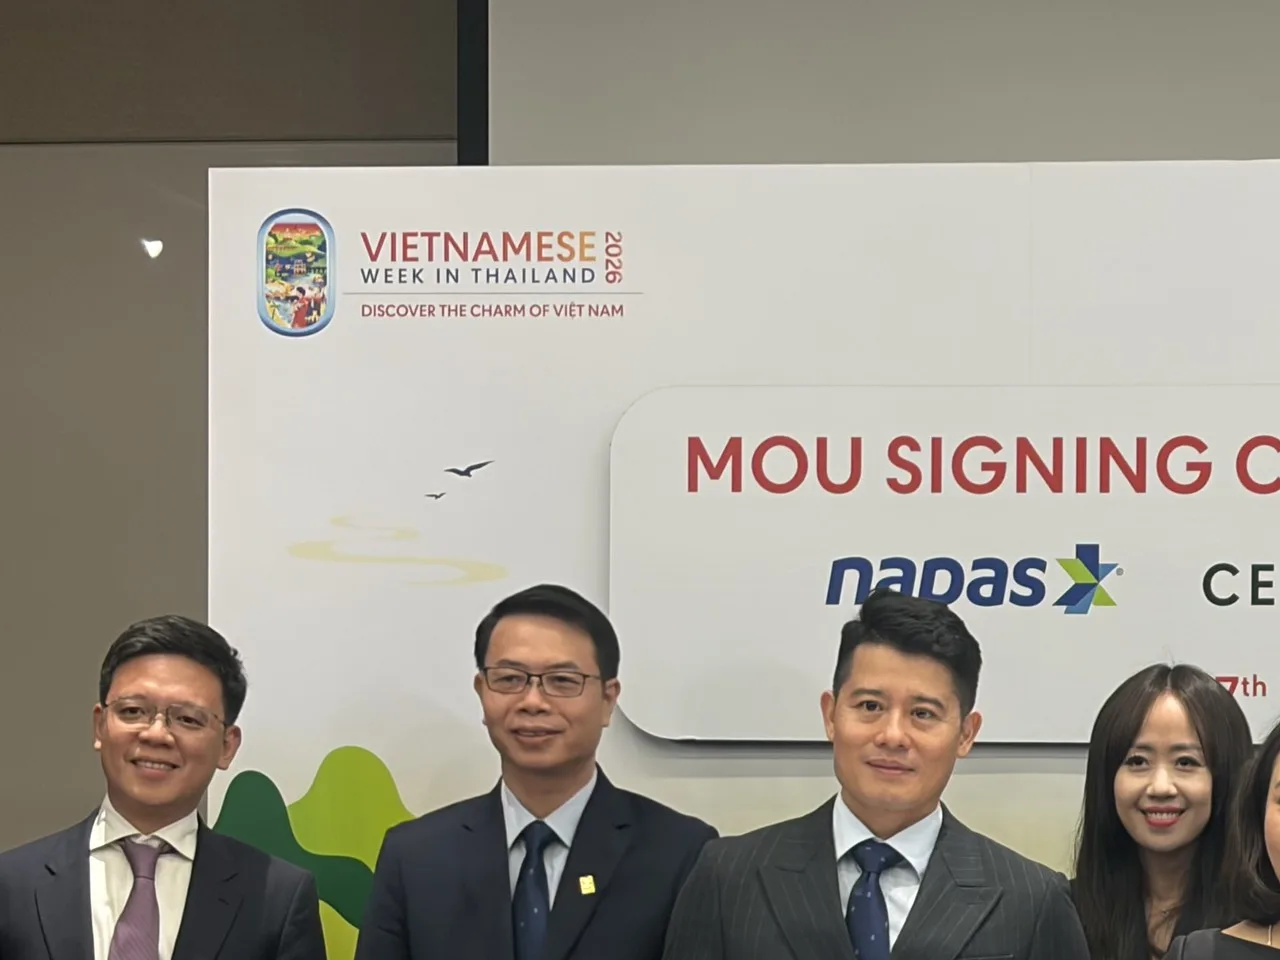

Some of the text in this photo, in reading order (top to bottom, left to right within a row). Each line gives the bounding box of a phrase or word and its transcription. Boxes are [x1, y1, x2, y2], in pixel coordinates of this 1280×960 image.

[361, 231, 596, 262] VIETNAMESE
[605, 232, 622, 283] 2026
[361, 268, 595, 284] WEEK IN THAILAND
[362, 304, 435, 317] DISCOVER
[439, 305, 466, 317] THE
[470, 304, 525, 317] CHARM
[530, 304, 549, 317] OF
[589, 304, 623, 317] NAM
[688, 436, 861, 494] MOU
[886, 436, 1212, 494] SIGNING
[826, 557, 1047, 610] napas
